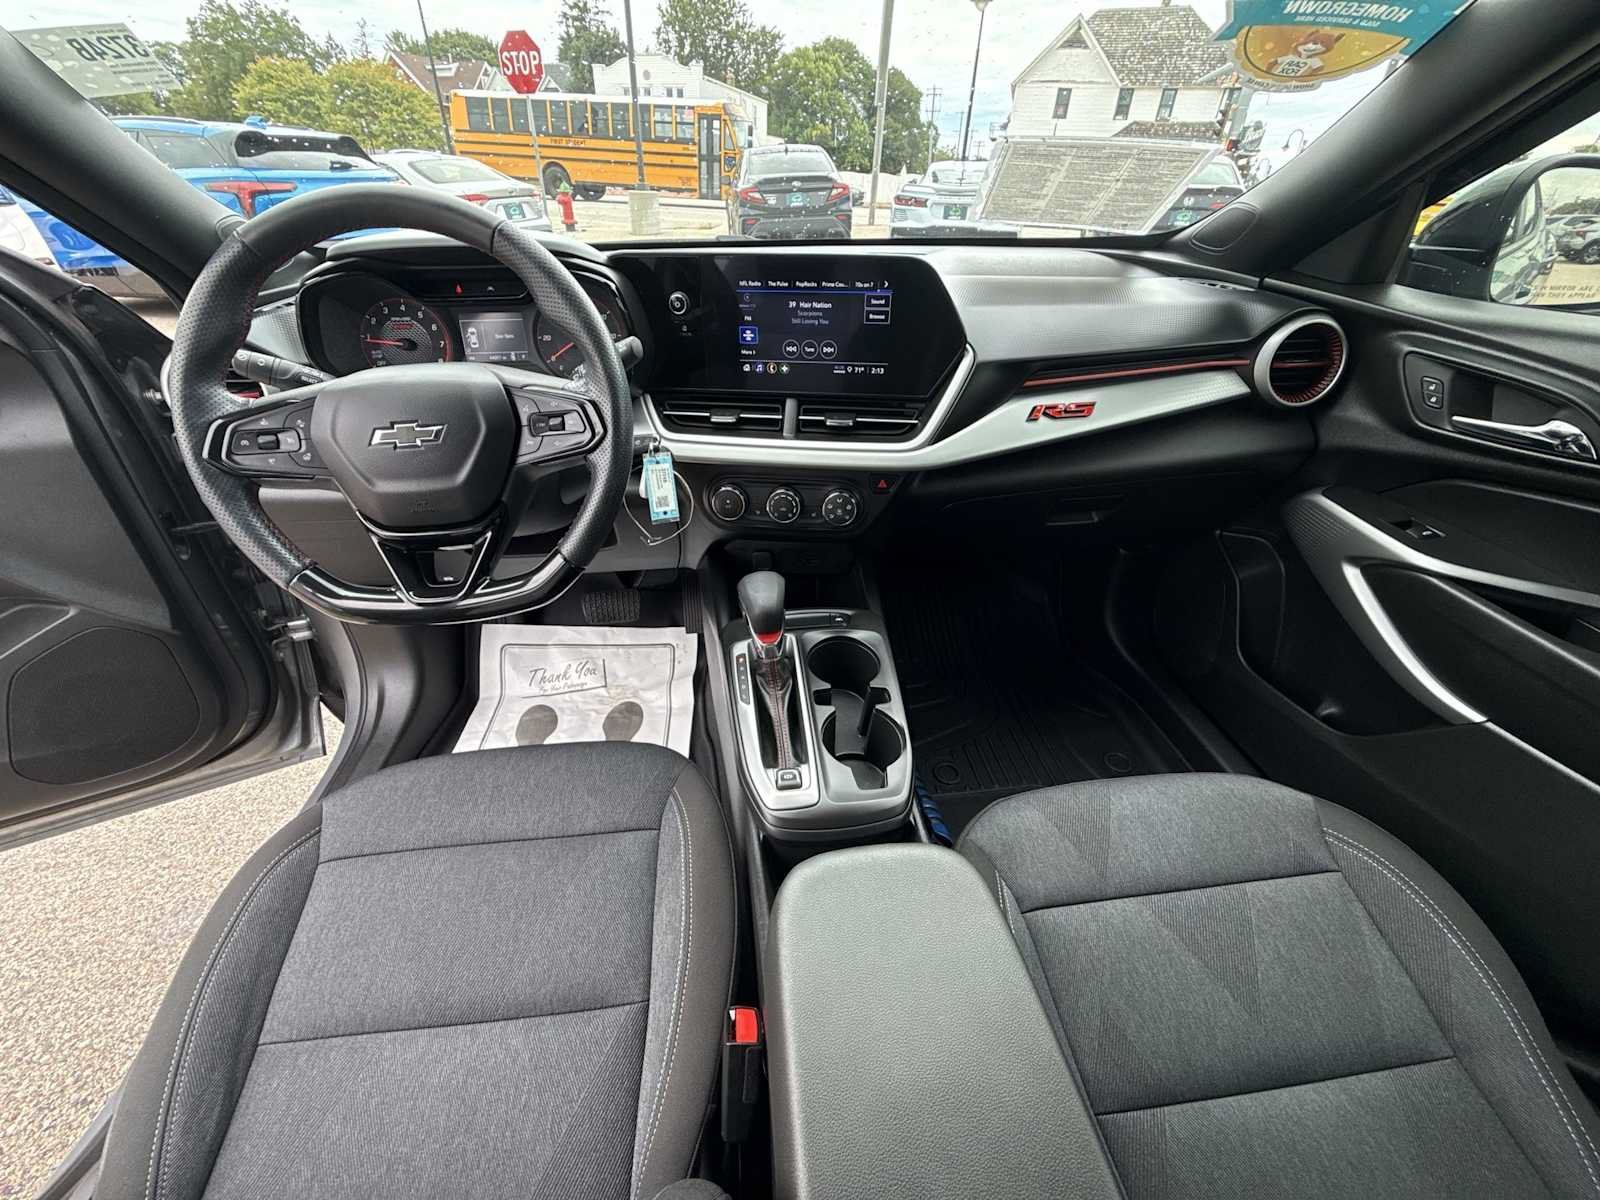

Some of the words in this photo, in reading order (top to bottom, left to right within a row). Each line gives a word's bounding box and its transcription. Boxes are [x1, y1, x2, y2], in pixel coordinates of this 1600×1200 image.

[502, 50, 539, 75] STOP
[799, 301, 812, 309] Hair
[813, 301, 832, 309] Nation
[418, 311, 423, 319] 5
[432, 323, 437, 331] 6
[1026, 402, 1096, 421] RS
[529, 663, 572, 687] Thank
[575, 660, 598, 679] You
